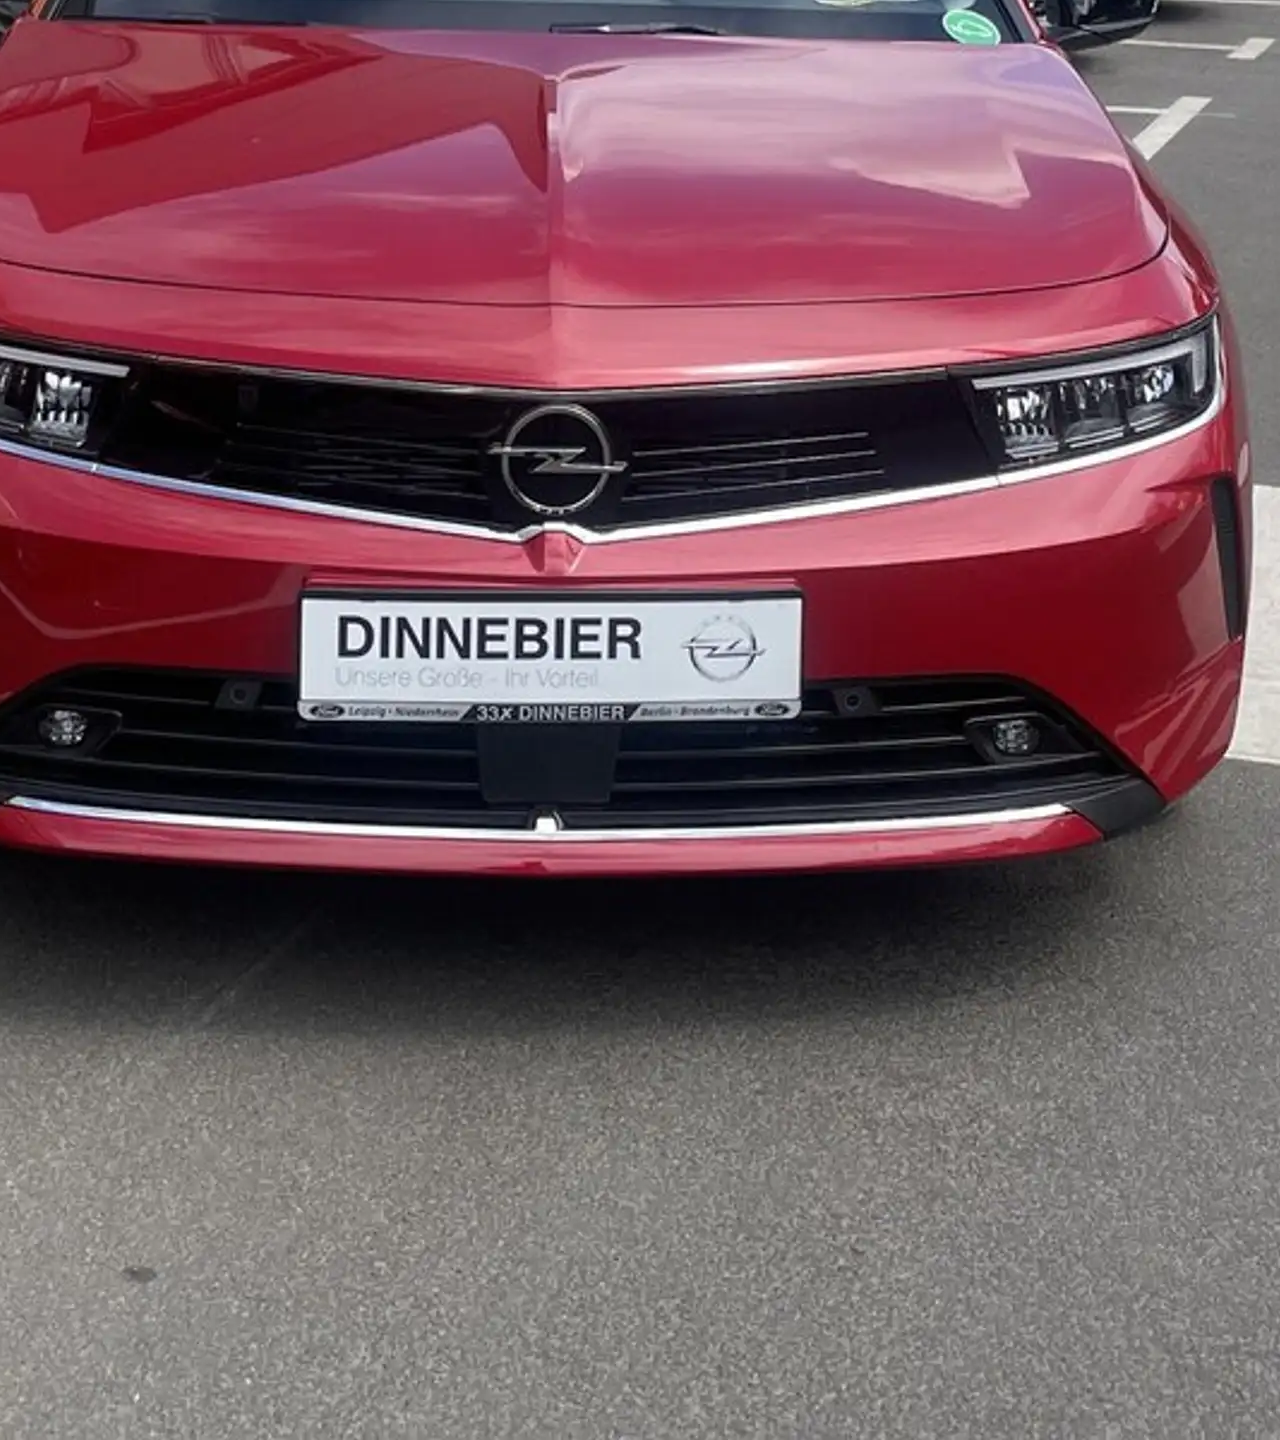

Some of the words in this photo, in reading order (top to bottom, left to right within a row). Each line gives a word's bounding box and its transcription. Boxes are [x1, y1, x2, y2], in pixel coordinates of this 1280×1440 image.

[338, 615, 641, 660] DINNEBIER
[334, 666, 412, 687] Unsere
[505, 667, 530, 688] Ihr
[536, 667, 599, 688] Vorteil
[519, 705, 625, 721] DINNEBIER
